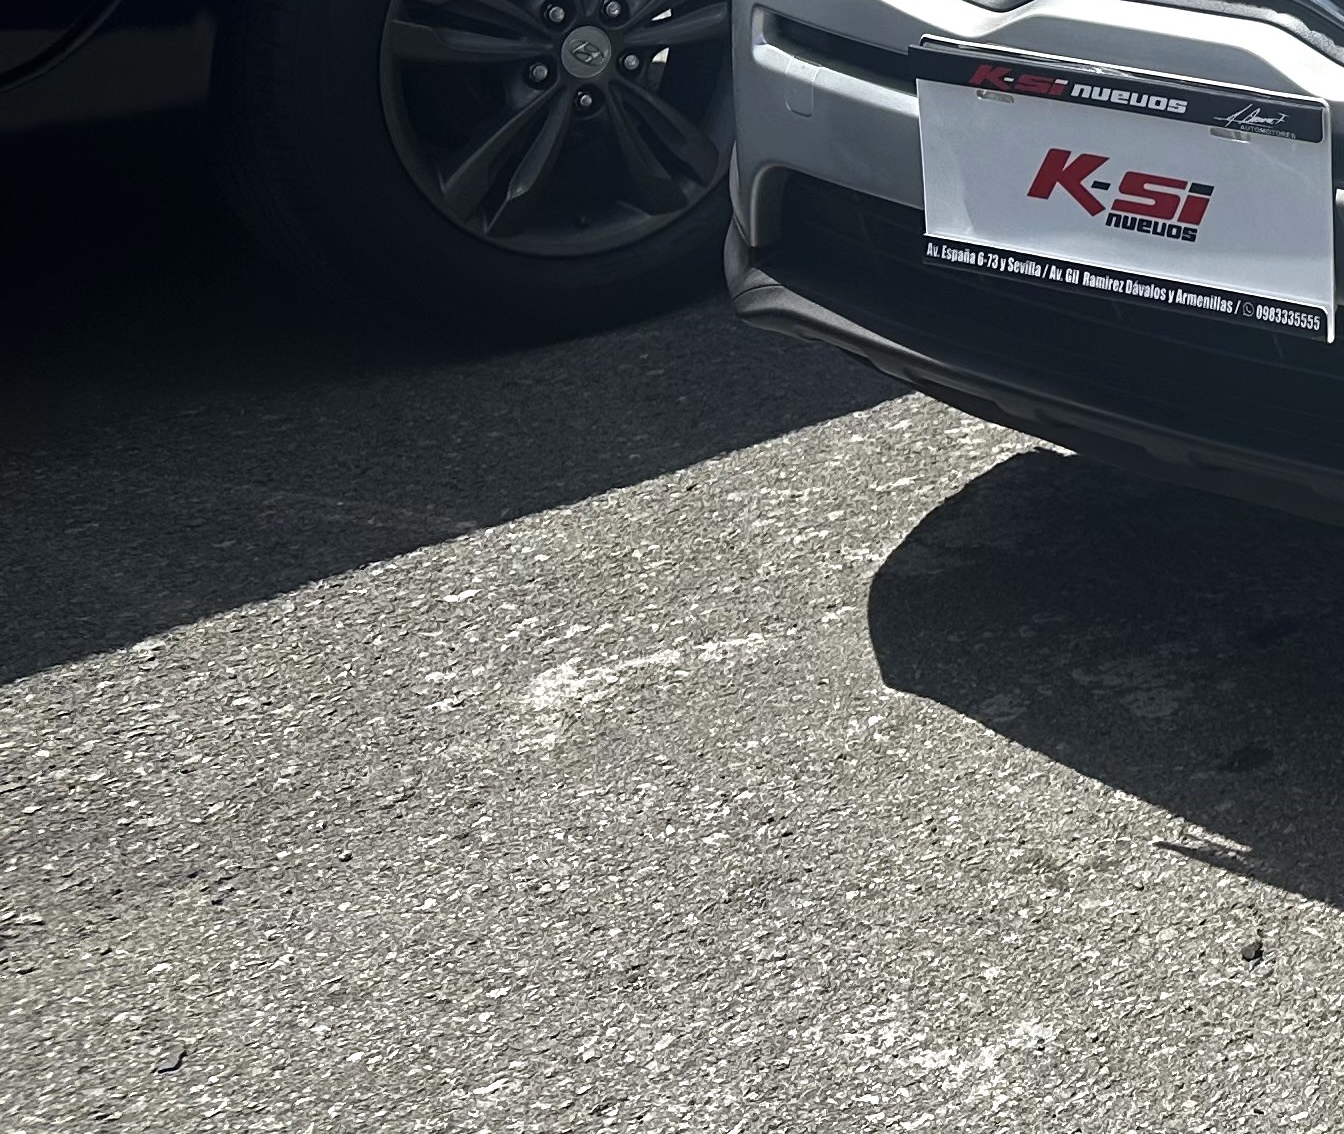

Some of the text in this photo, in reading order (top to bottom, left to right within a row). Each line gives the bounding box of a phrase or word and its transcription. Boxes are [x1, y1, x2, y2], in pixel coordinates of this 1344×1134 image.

[941, 245, 975, 265] España
[977, 252, 999, 269] 6-73
[1000, 258, 1006, 272] y
[1007, 257, 1041, 277] Sevilla
[1049, 265, 1063, 281] Av.
[1125, 279, 1166, 300] Dávalos
[1168, 290, 1175, 303] y
[1175, 288, 1233, 314] Armenillas
[1256, 304, 1320, 331] 0983335555
